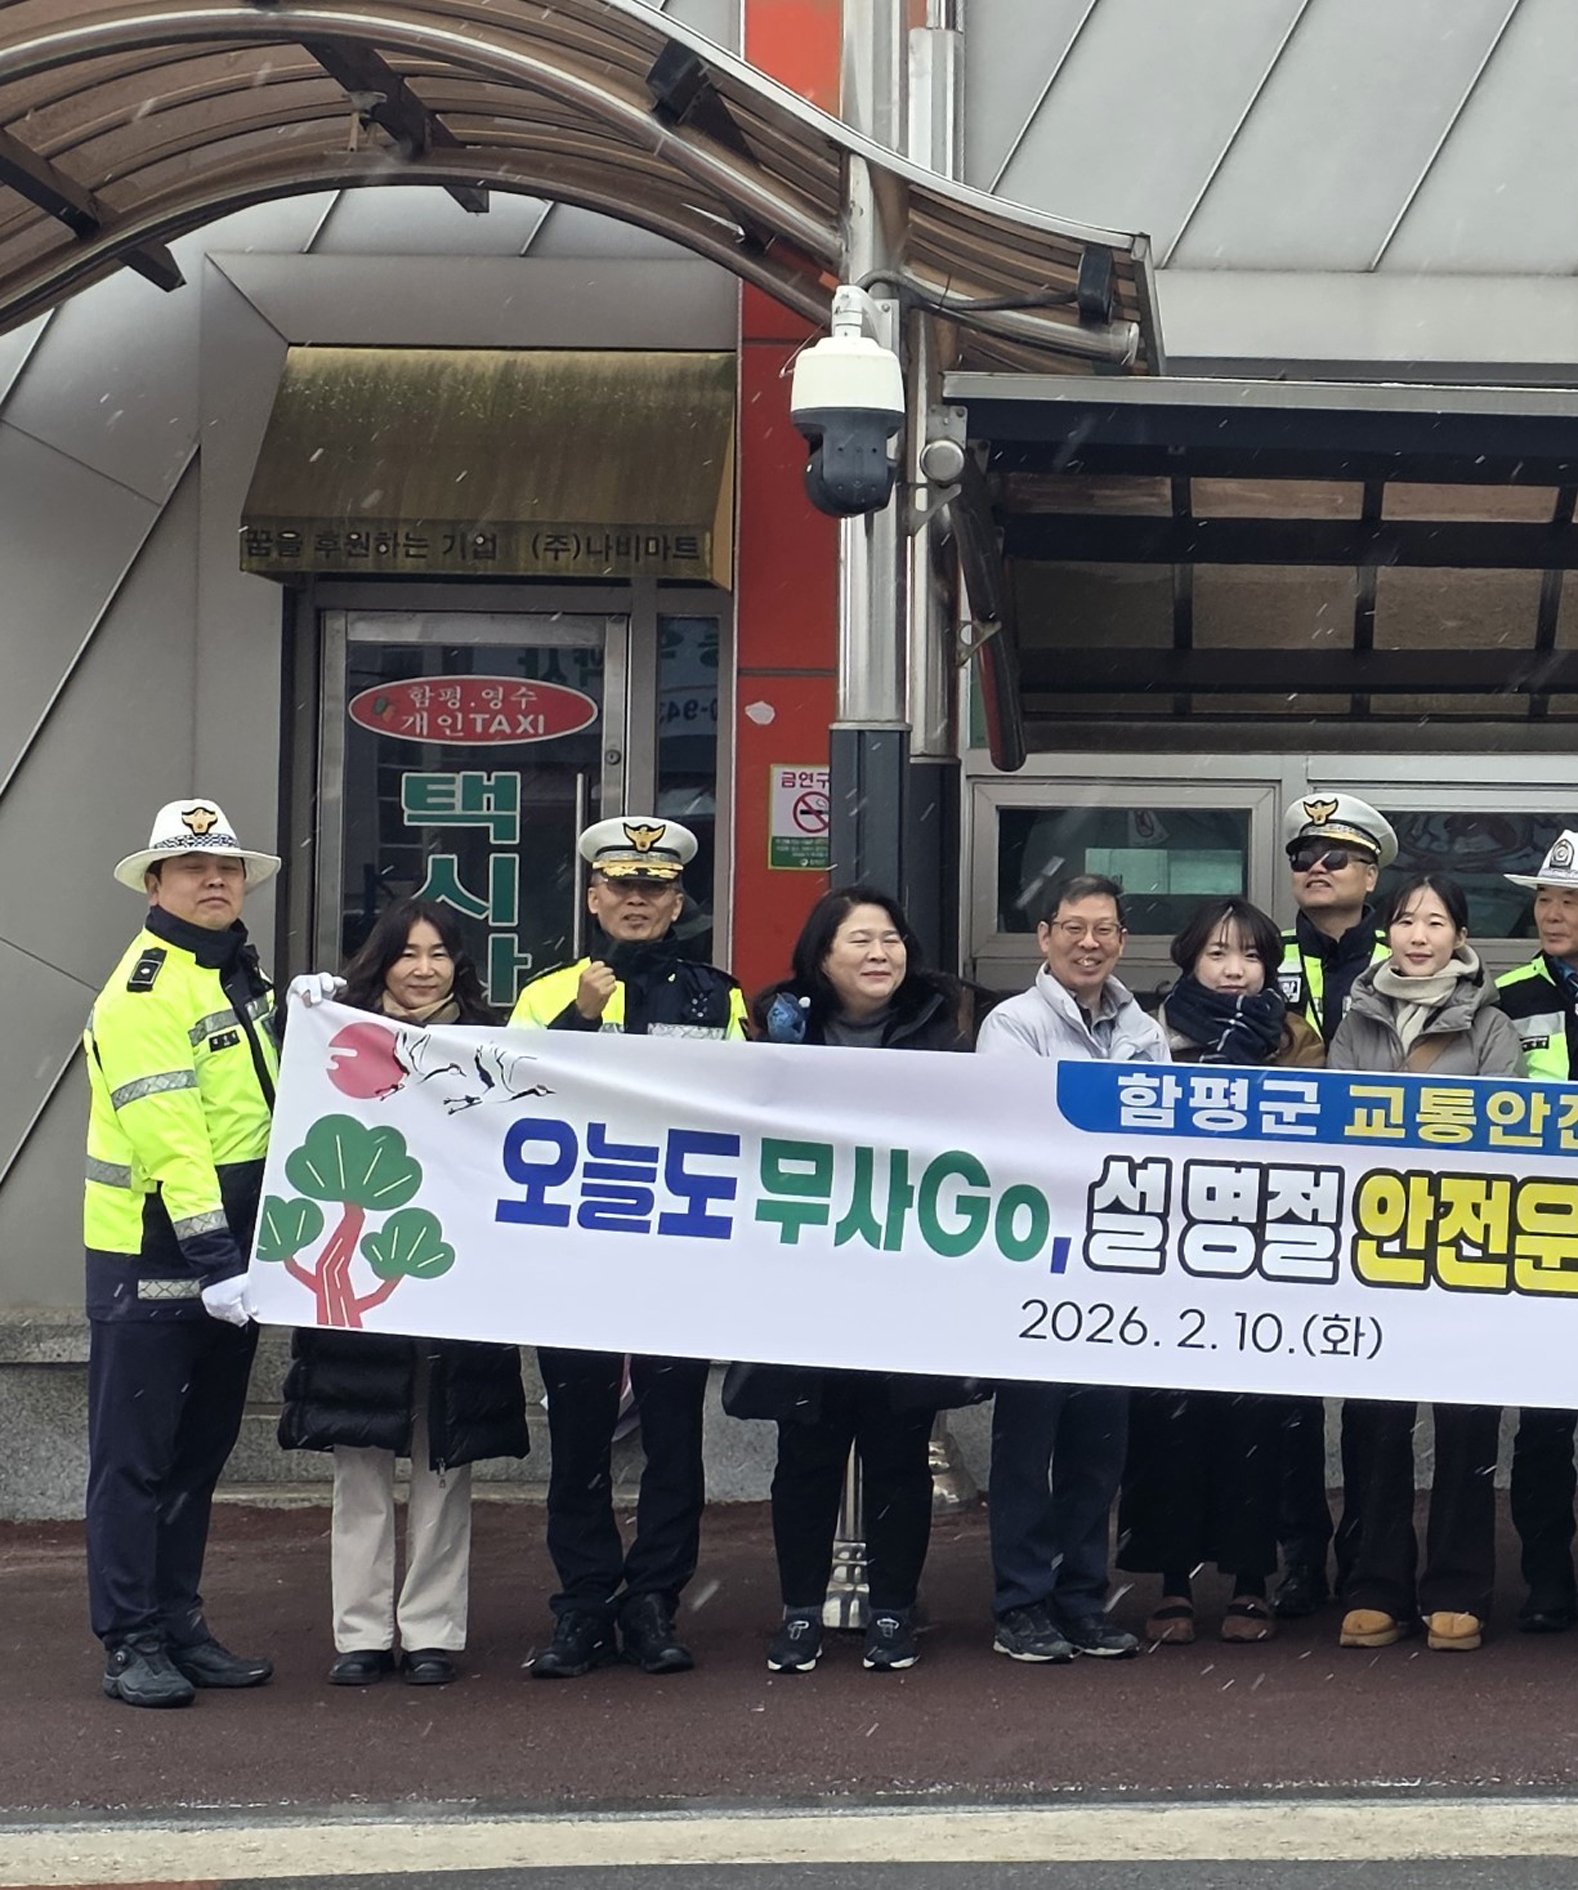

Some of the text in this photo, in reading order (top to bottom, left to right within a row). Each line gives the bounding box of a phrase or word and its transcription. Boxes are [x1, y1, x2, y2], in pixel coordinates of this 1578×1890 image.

[244, 527, 700, 563] 꿈을 후원하는 기업 (주)나비마트
[408, 685, 538, 710] 함평.영수
[400, 711, 545, 737] 개인TAXI
[781, 771, 829, 789] 금연구
[1117, 1071, 1322, 1137] 함평군
[494, 1117, 741, 1240] 오늘도
[754, 1136, 1072, 1274] 무사Go,
[1018, 1298, 1161, 1348] 2026.
